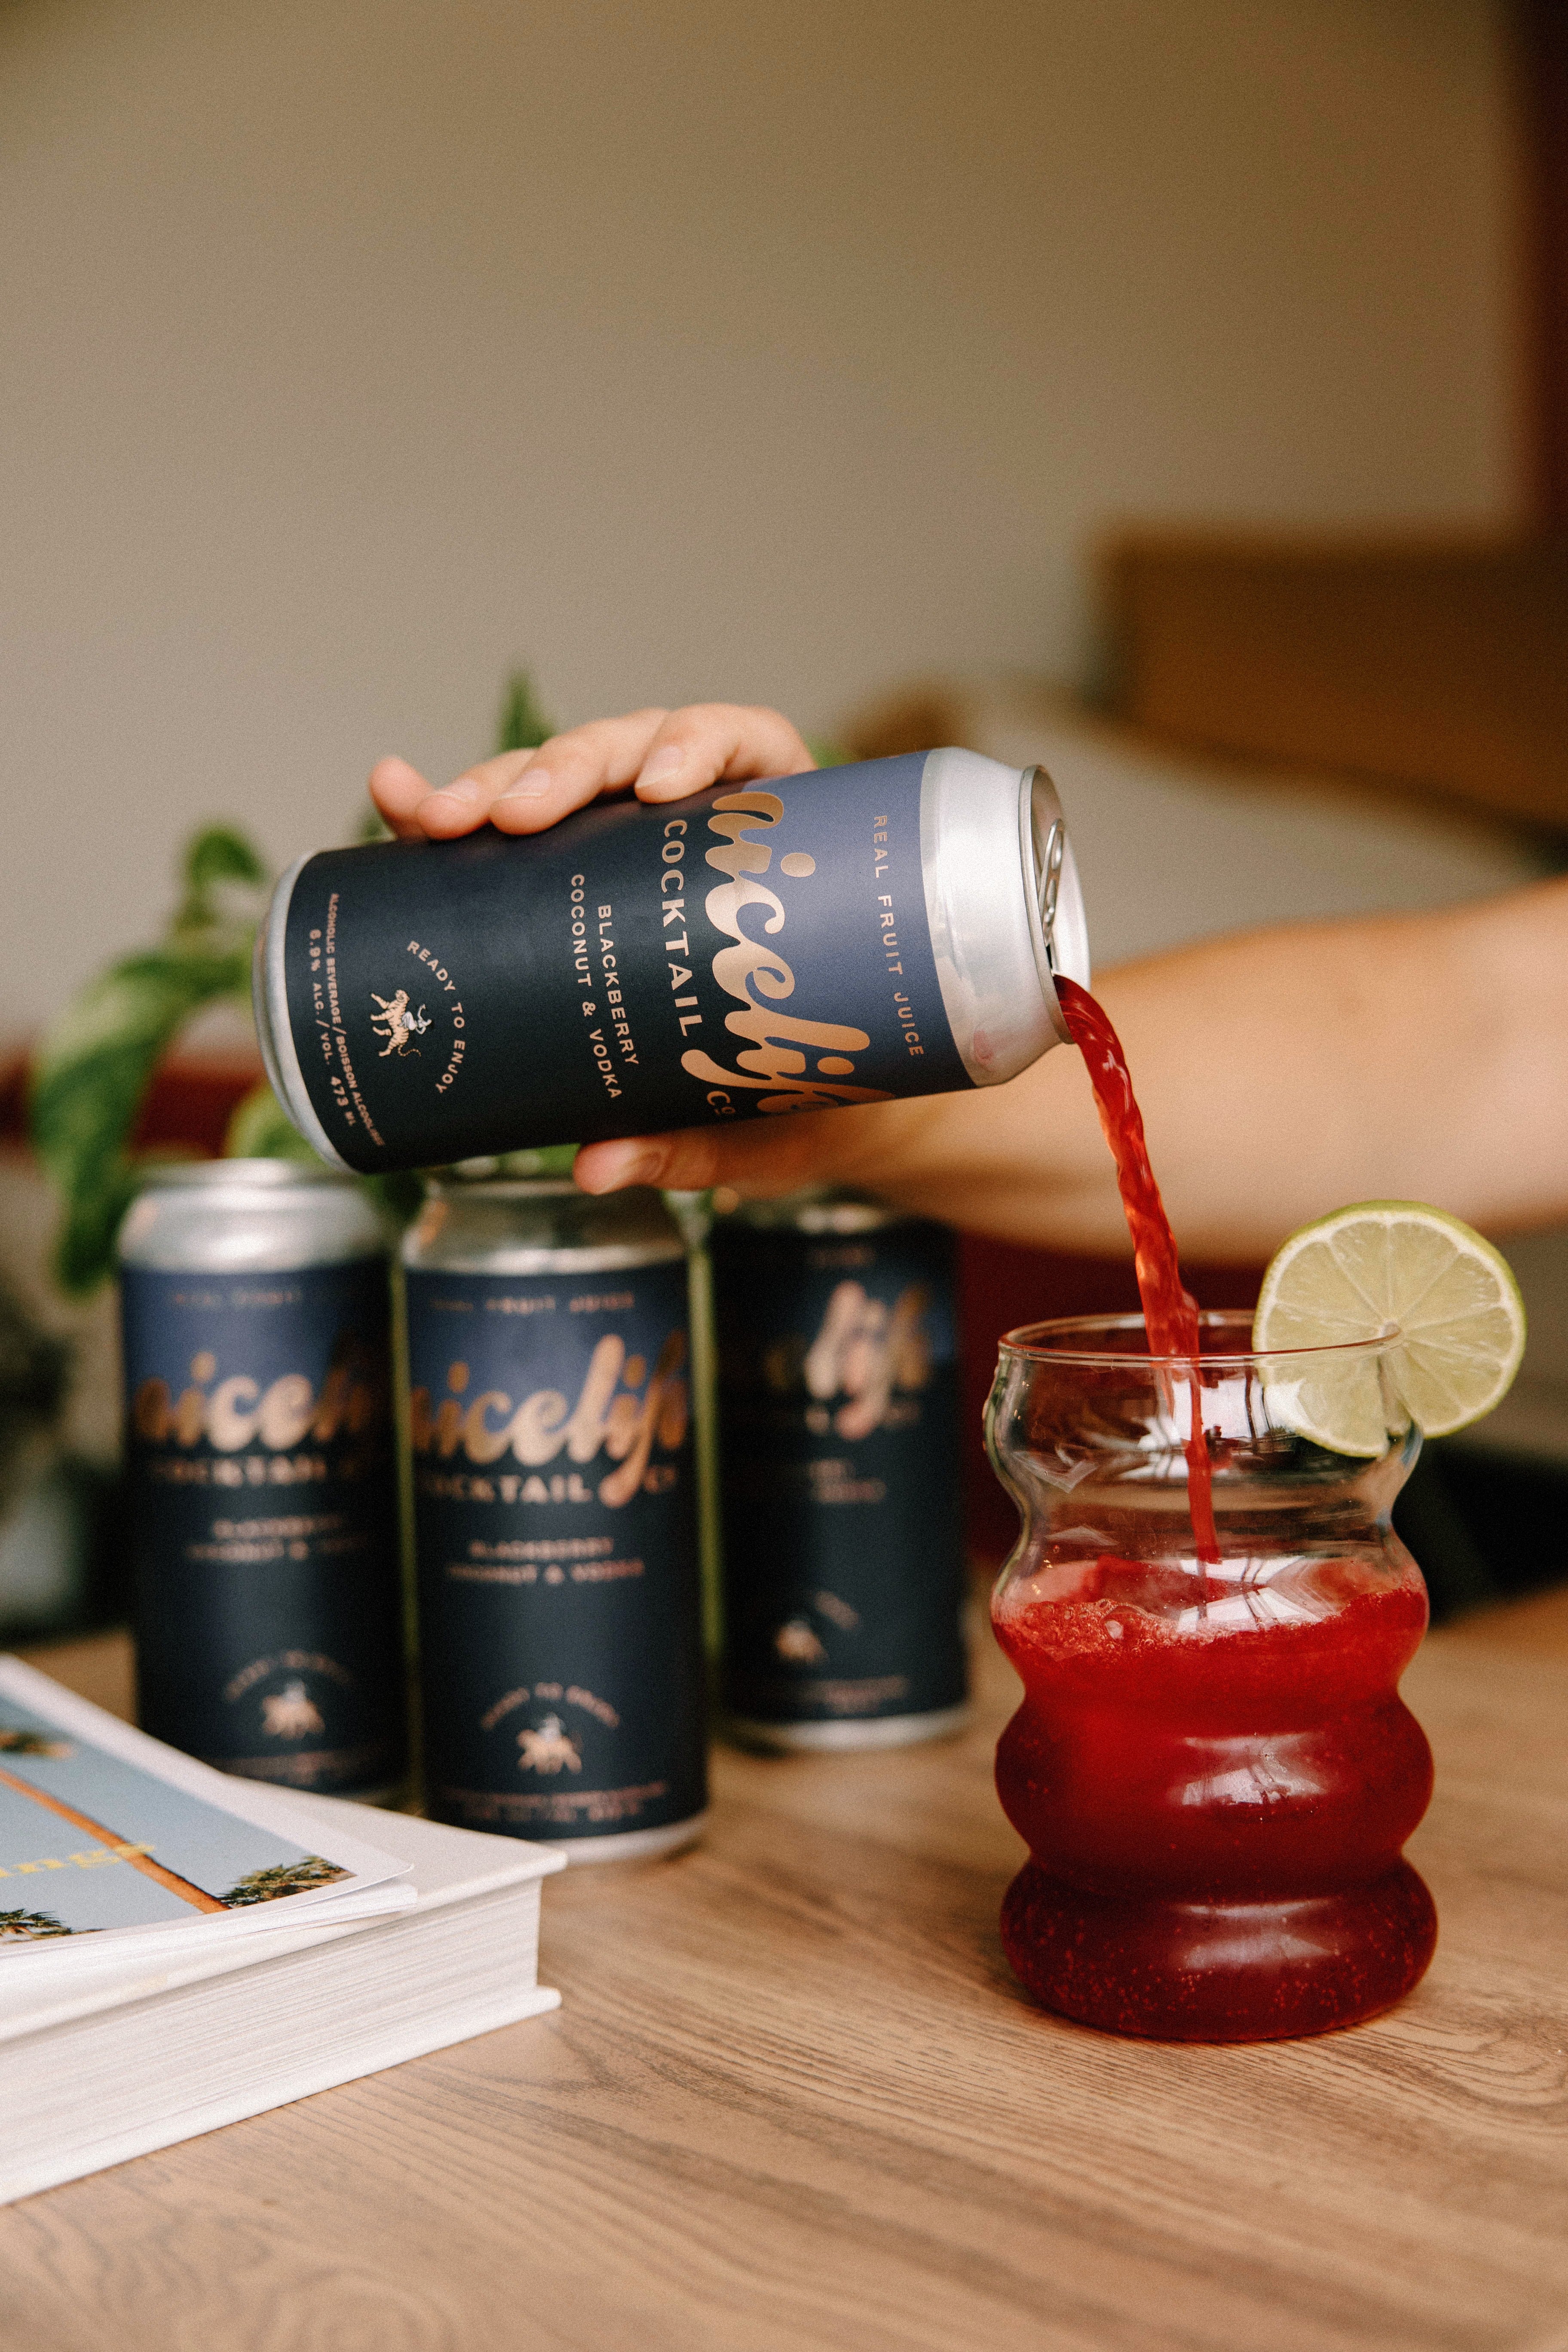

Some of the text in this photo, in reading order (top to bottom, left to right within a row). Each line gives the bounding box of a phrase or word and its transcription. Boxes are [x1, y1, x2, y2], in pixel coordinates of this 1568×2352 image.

[326, 893, 339, 954] ALCOHOLIC
[571, 874, 622, 1099] COCONUT & VODKA
[598, 905, 639, 1066] BLACKBERRY
[661, 820, 703, 1037] COCKTAIL
[874, 815, 925, 1056] REAL FRUIT JUICE
[331, 1076, 349, 1106] 473
[407, 940, 466, 1094] READY TO ENJOY
